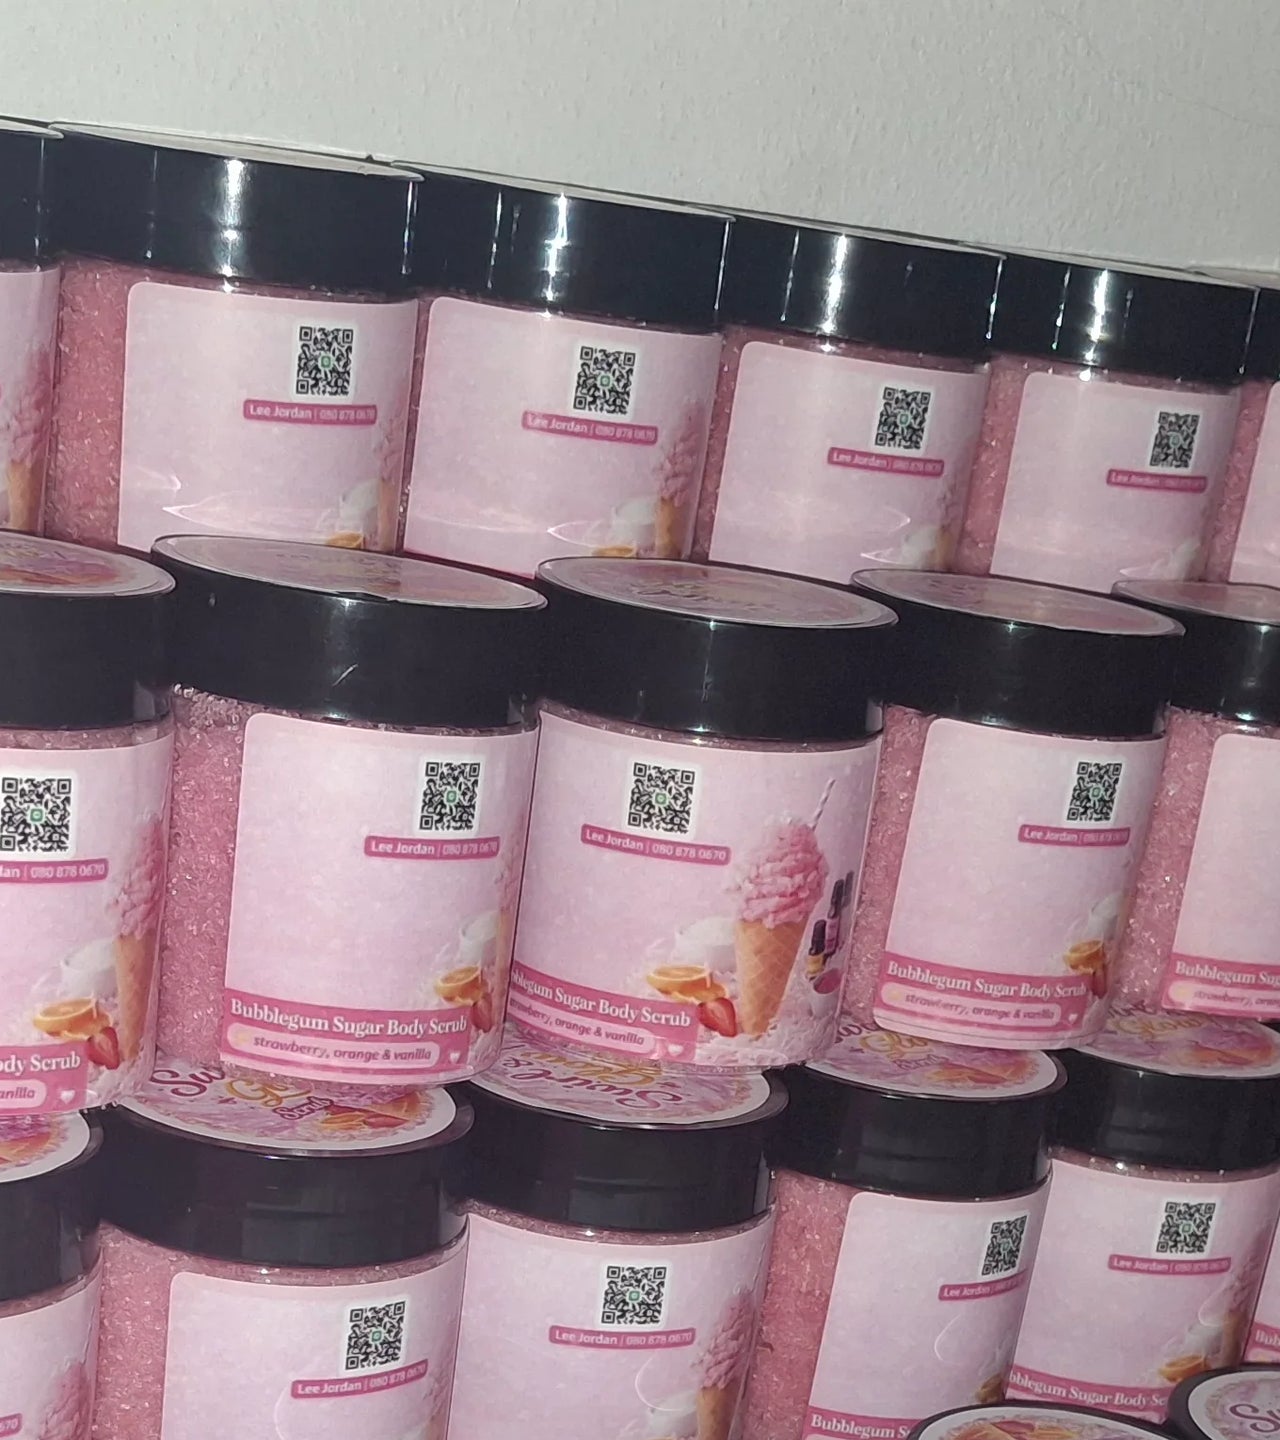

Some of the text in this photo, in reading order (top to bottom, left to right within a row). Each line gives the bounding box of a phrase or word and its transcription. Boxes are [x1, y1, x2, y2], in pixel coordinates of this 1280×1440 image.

[249, 405, 312, 419] Lee Jordan
[527, 413, 587, 434] Lee Jordan
[833, 452, 851, 464] Lee
[851, 454, 888, 468] Jordan
[585, 830, 726, 861] Lee Jordan 080 878 0670
[1024, 828, 1044, 840] Lee
[1045, 828, 1078, 842] Jordan
[371, 841, 435, 855] Lee Jordan
[887, 960, 1087, 999] Bubblegum Sugar Body Scrub
[1175, 960, 1256, 984] Bubblegum
[554, 988, 691, 1027] Sugar Body Scrub
[971, 1006, 1010, 1020] orange
[1021, 1009, 1054, 1020] vanilla
[230, 998, 468, 1039] Bubblegum Sugar Body Scrub
[554, 1017, 592, 1036] orange
[605, 1029, 645, 1046] vanilla
[253, 1034, 432, 1063] strawberry, orange & vanilla
[29, 1051, 81, 1072] Scrub
[272, 1096, 334, 1120] Scrub
[1113, 1257, 1132, 1267] Lee
[1133, 1258, 1168, 1271] Jordan
[943, 1287, 960, 1298] Lee
[961, 1285, 991, 1296] Jordan
[555, 1330, 618, 1346] Lee Jordan
[297, 1381, 362, 1394] Lee Jordan
[1068, 1386, 1113, 1406] Sugar
[1113, 1391, 1150, 1408] Body
[811, 1413, 895, 1440] Bubblegum
